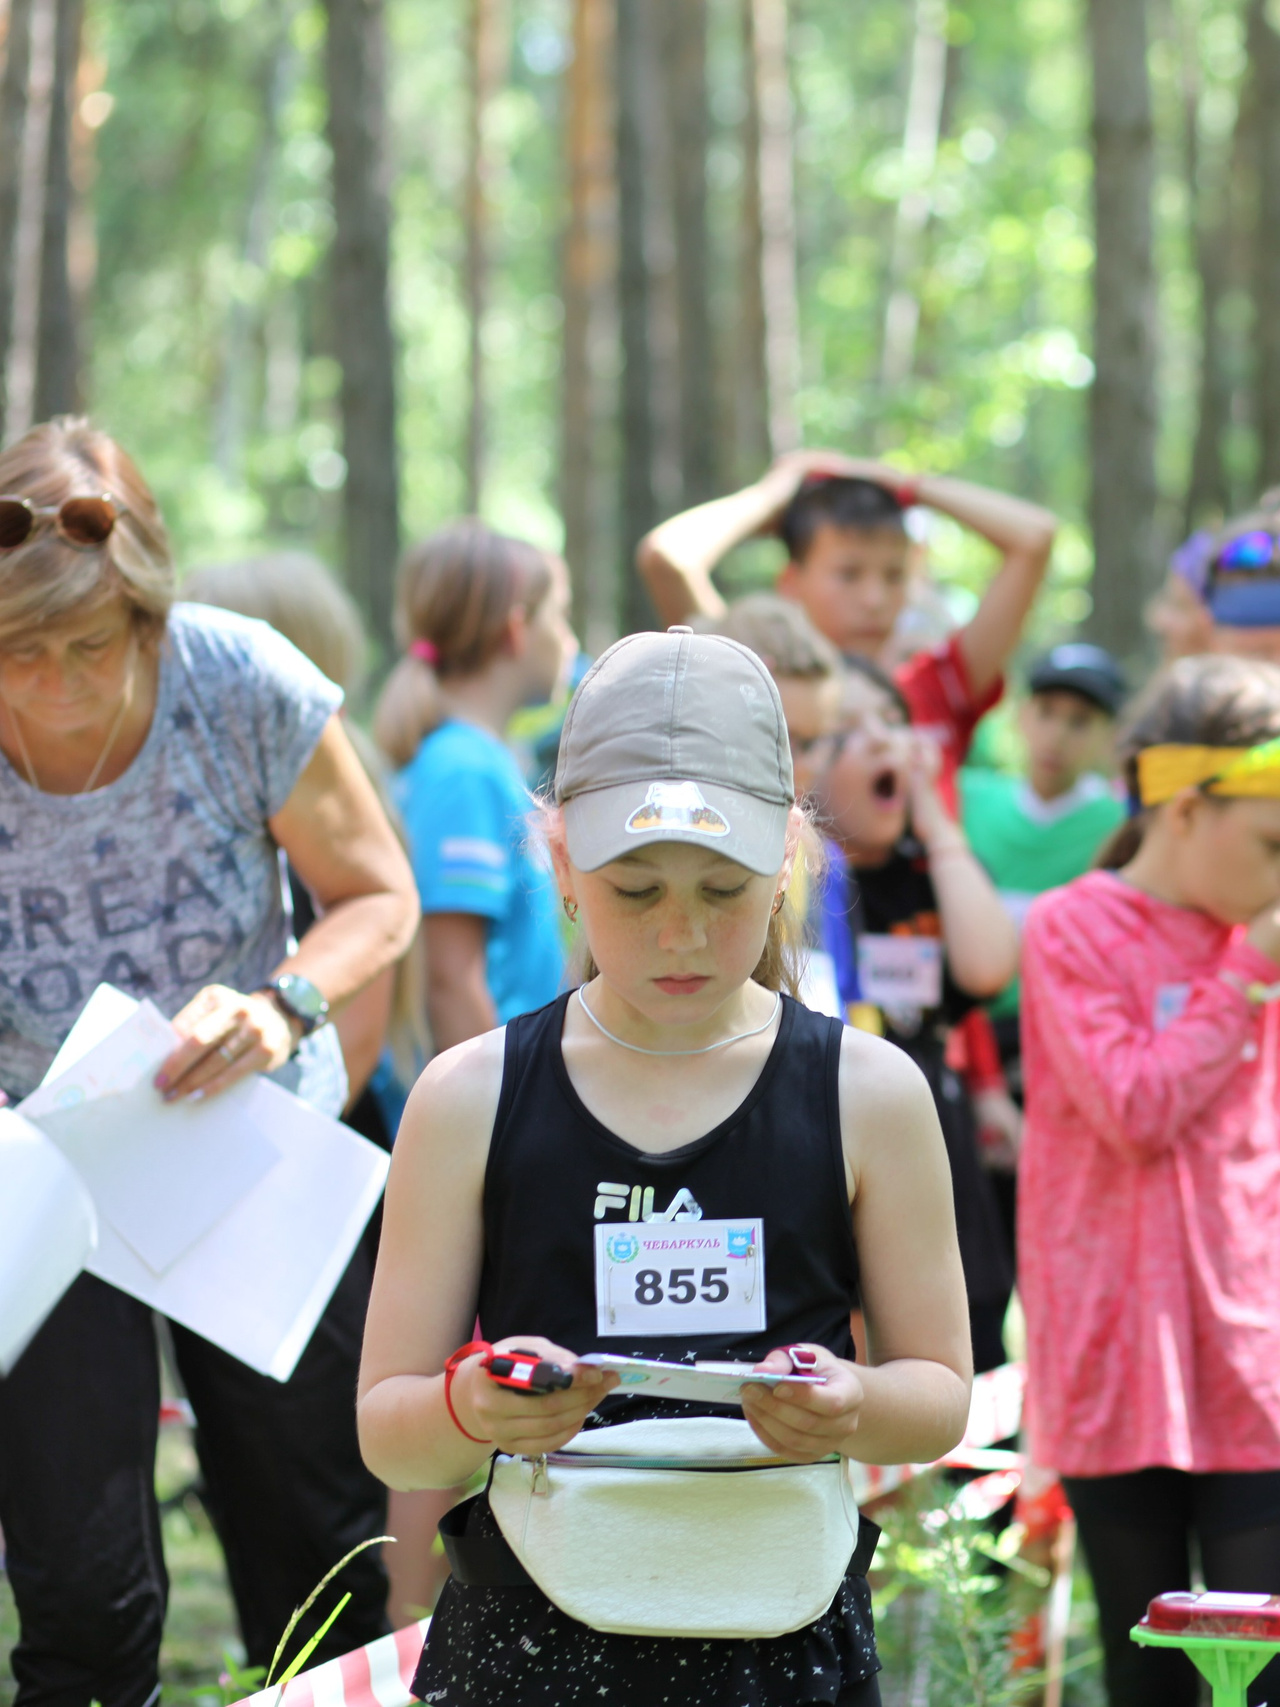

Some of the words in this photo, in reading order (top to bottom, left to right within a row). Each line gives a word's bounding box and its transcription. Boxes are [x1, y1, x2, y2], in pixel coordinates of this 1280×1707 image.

[593, 1181, 703, 1224] FILA
[642, 1237, 721, 1251] ЧЕБАРКУЛЬ
[634, 1267, 730, 1306] 855
